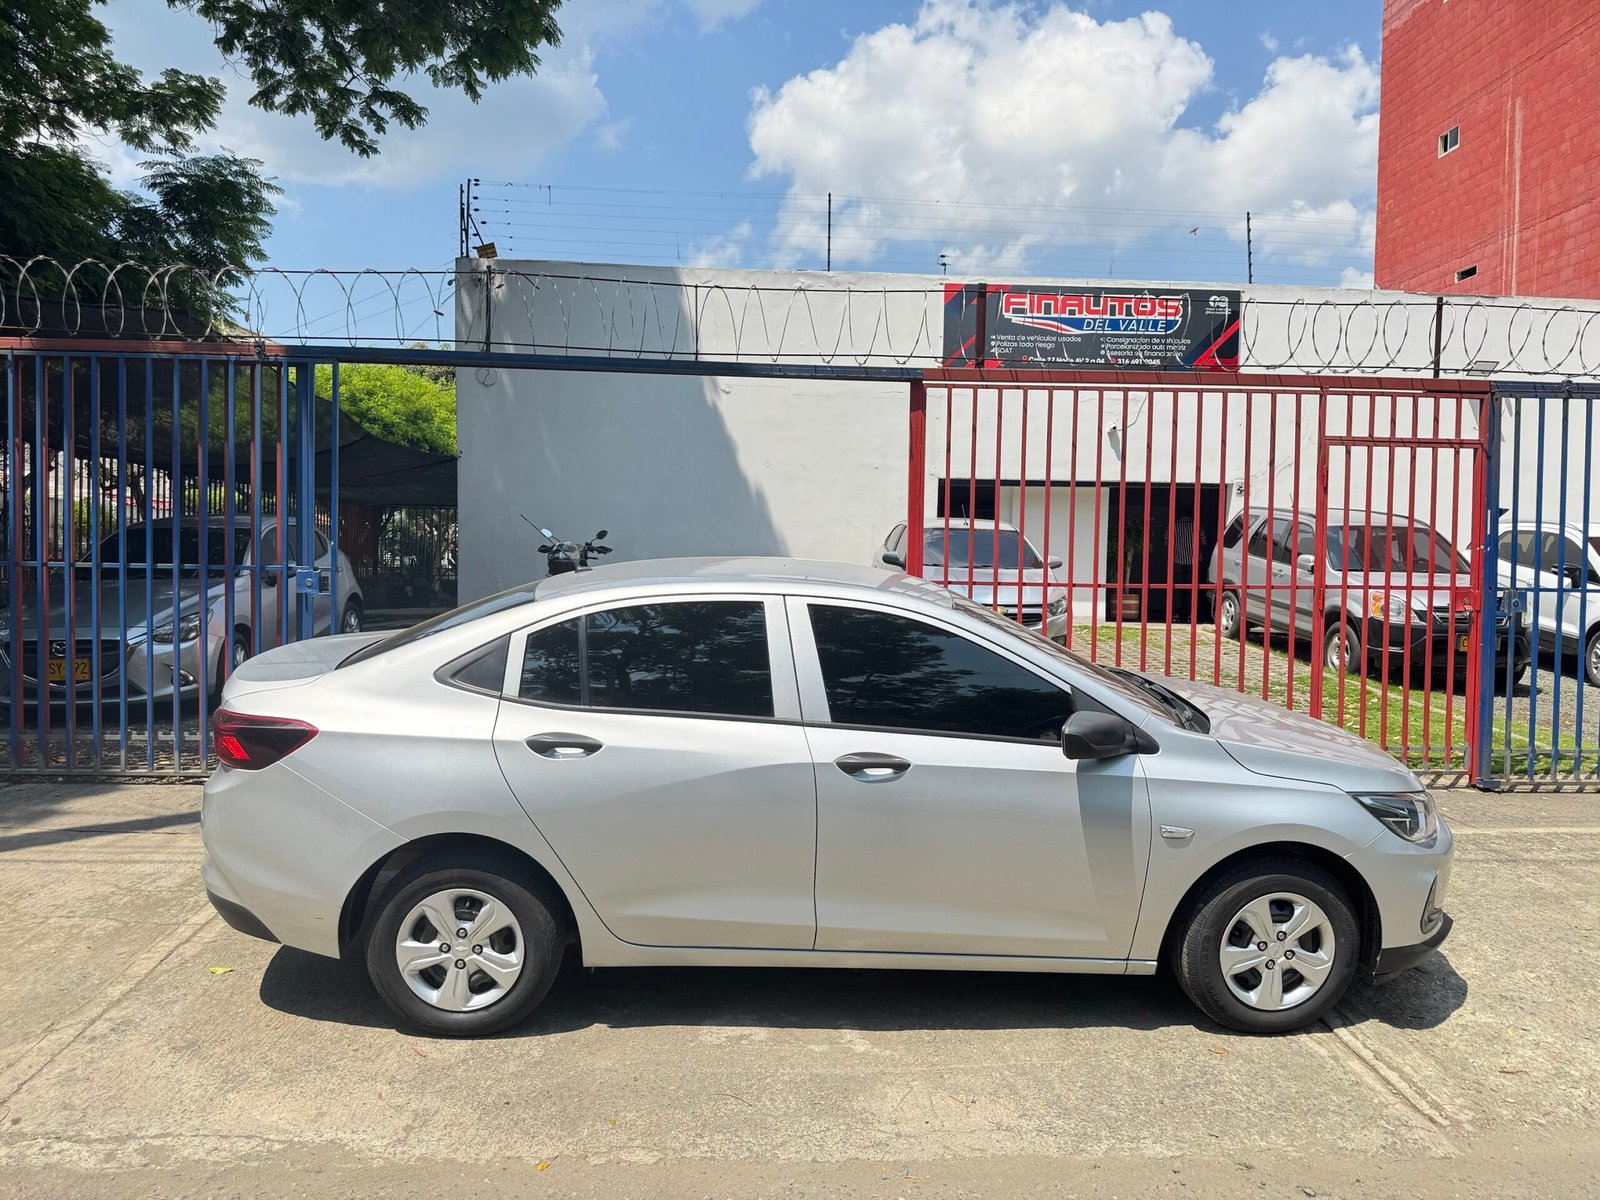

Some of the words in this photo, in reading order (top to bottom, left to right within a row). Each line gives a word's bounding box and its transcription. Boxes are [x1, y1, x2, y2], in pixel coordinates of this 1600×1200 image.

[1003, 293, 1183, 318] FINAUTOS
[1083, 319, 1112, 331] DEL
[1119, 320, 1167, 332] VALLE
[1035, 341, 1056, 350] riesgo
